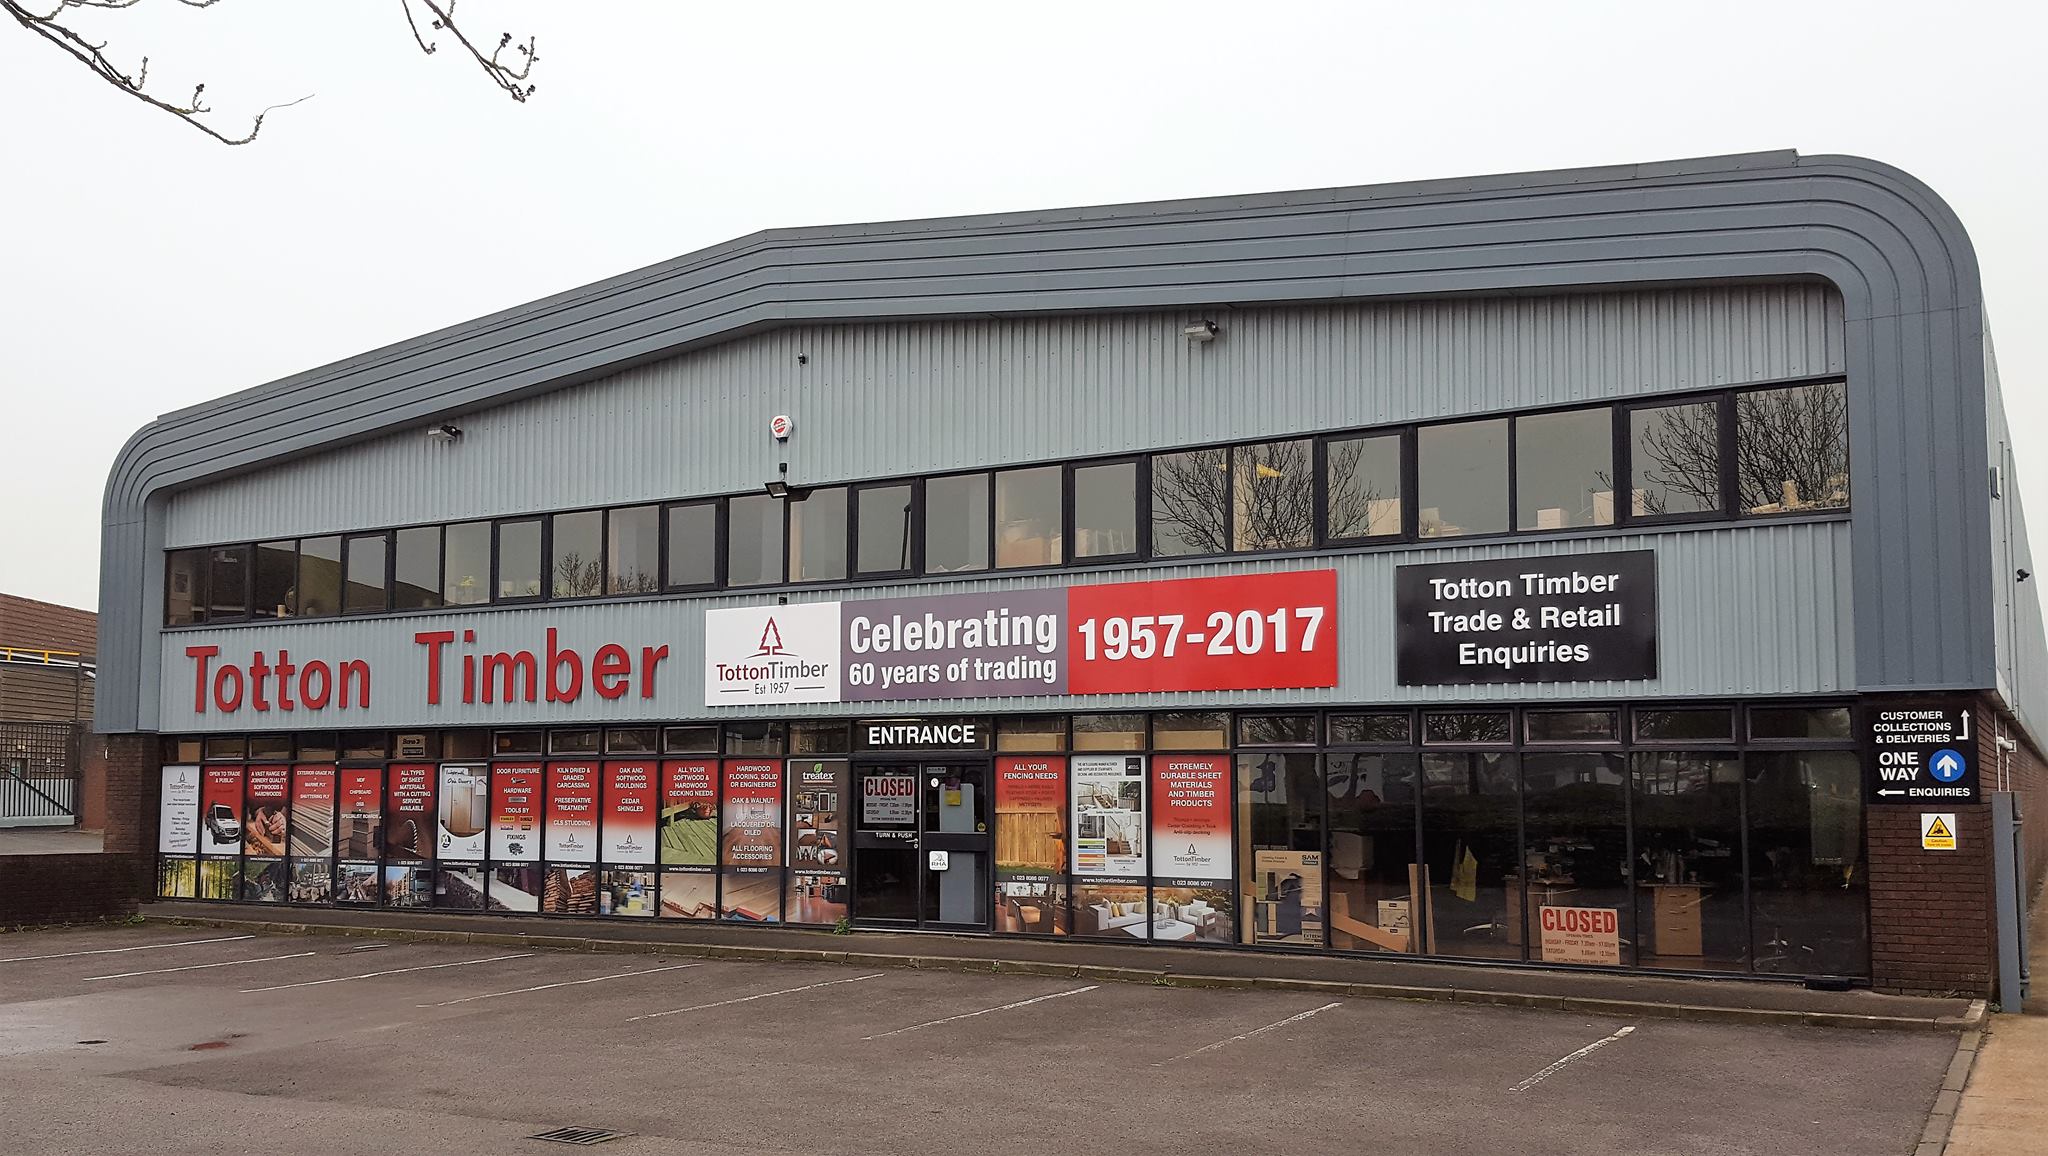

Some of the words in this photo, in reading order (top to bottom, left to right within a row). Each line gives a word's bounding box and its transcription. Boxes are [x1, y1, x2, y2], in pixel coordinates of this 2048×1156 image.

[1429, 578, 1511, 600] Totton
[1520, 571, 1619, 596] Timber
[1428, 609, 1502, 633] Trade
[1511, 608, 1530, 630] &
[1540, 604, 1620, 629] Retail
[848, 607, 1058, 656] Celebrating
[1078, 606, 1325, 661] 1957-2017
[1458, 640, 1590, 670] Enquiries
[185, 645, 370, 714] Totton
[414, 626, 670, 705] Timber
[716, 659, 828, 684] TottonTimber
[848, 662, 874, 687] 60
[880, 664, 942, 690] years
[946, 660, 968, 683] of
[974, 658, 1058, 684] trading
[753, 682, 768, 695] Est
[769, 681, 789, 694] 1957
[1880, 711, 1943, 720] CUSTOMER
[868, 725, 976, 744] ENTRANCE
[1874, 722, 1952, 732] COLLECTIONS
[1876, 736, 1884, 744] &
[1886, 734, 1950, 744] DELIVERIES
[1879, 752, 1919, 766] ONE
[803, 772, 834, 780] treatex
[1880, 768, 1919, 780] WAY
[865, 778, 913, 797] CLOSED
[1909, 788, 1970, 796] ENQUIRIES
[1542, 908, 1616, 933] CLOSED
